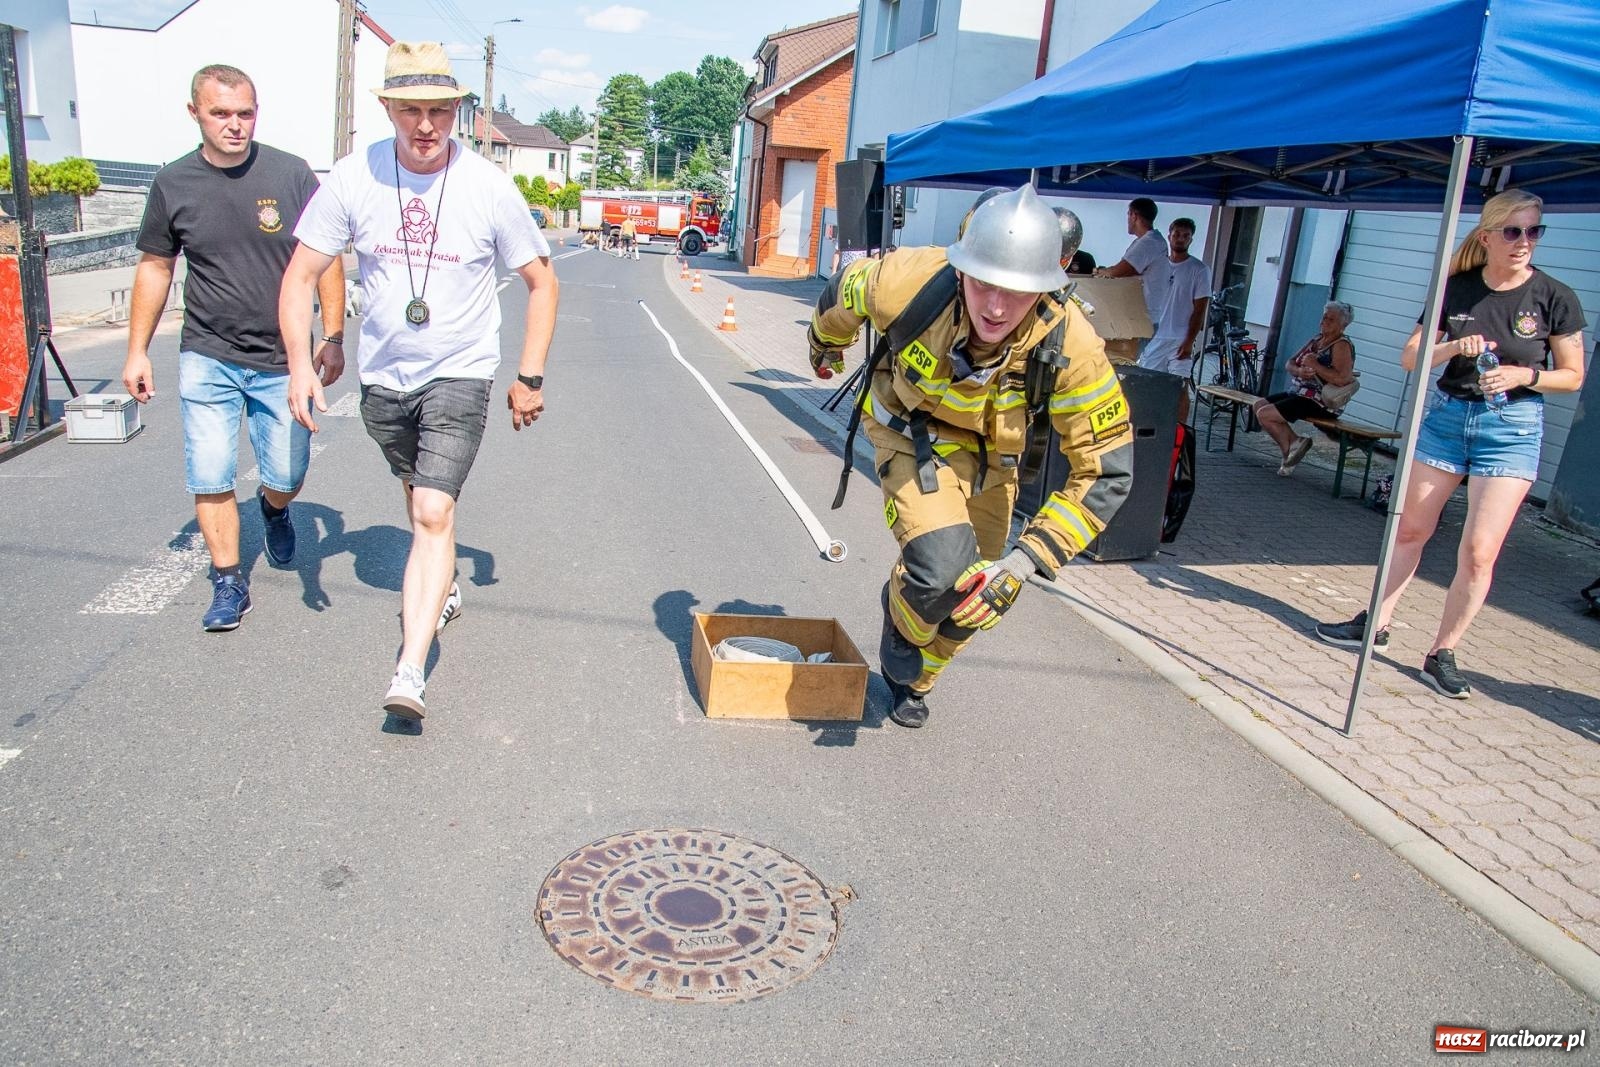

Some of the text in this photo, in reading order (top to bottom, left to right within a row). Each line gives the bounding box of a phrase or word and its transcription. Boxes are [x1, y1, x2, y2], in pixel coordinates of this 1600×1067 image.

[908, 344, 932, 370] PSP
[1097, 401, 1121, 426] PSP
[677, 934, 733, 948] ASTRA
